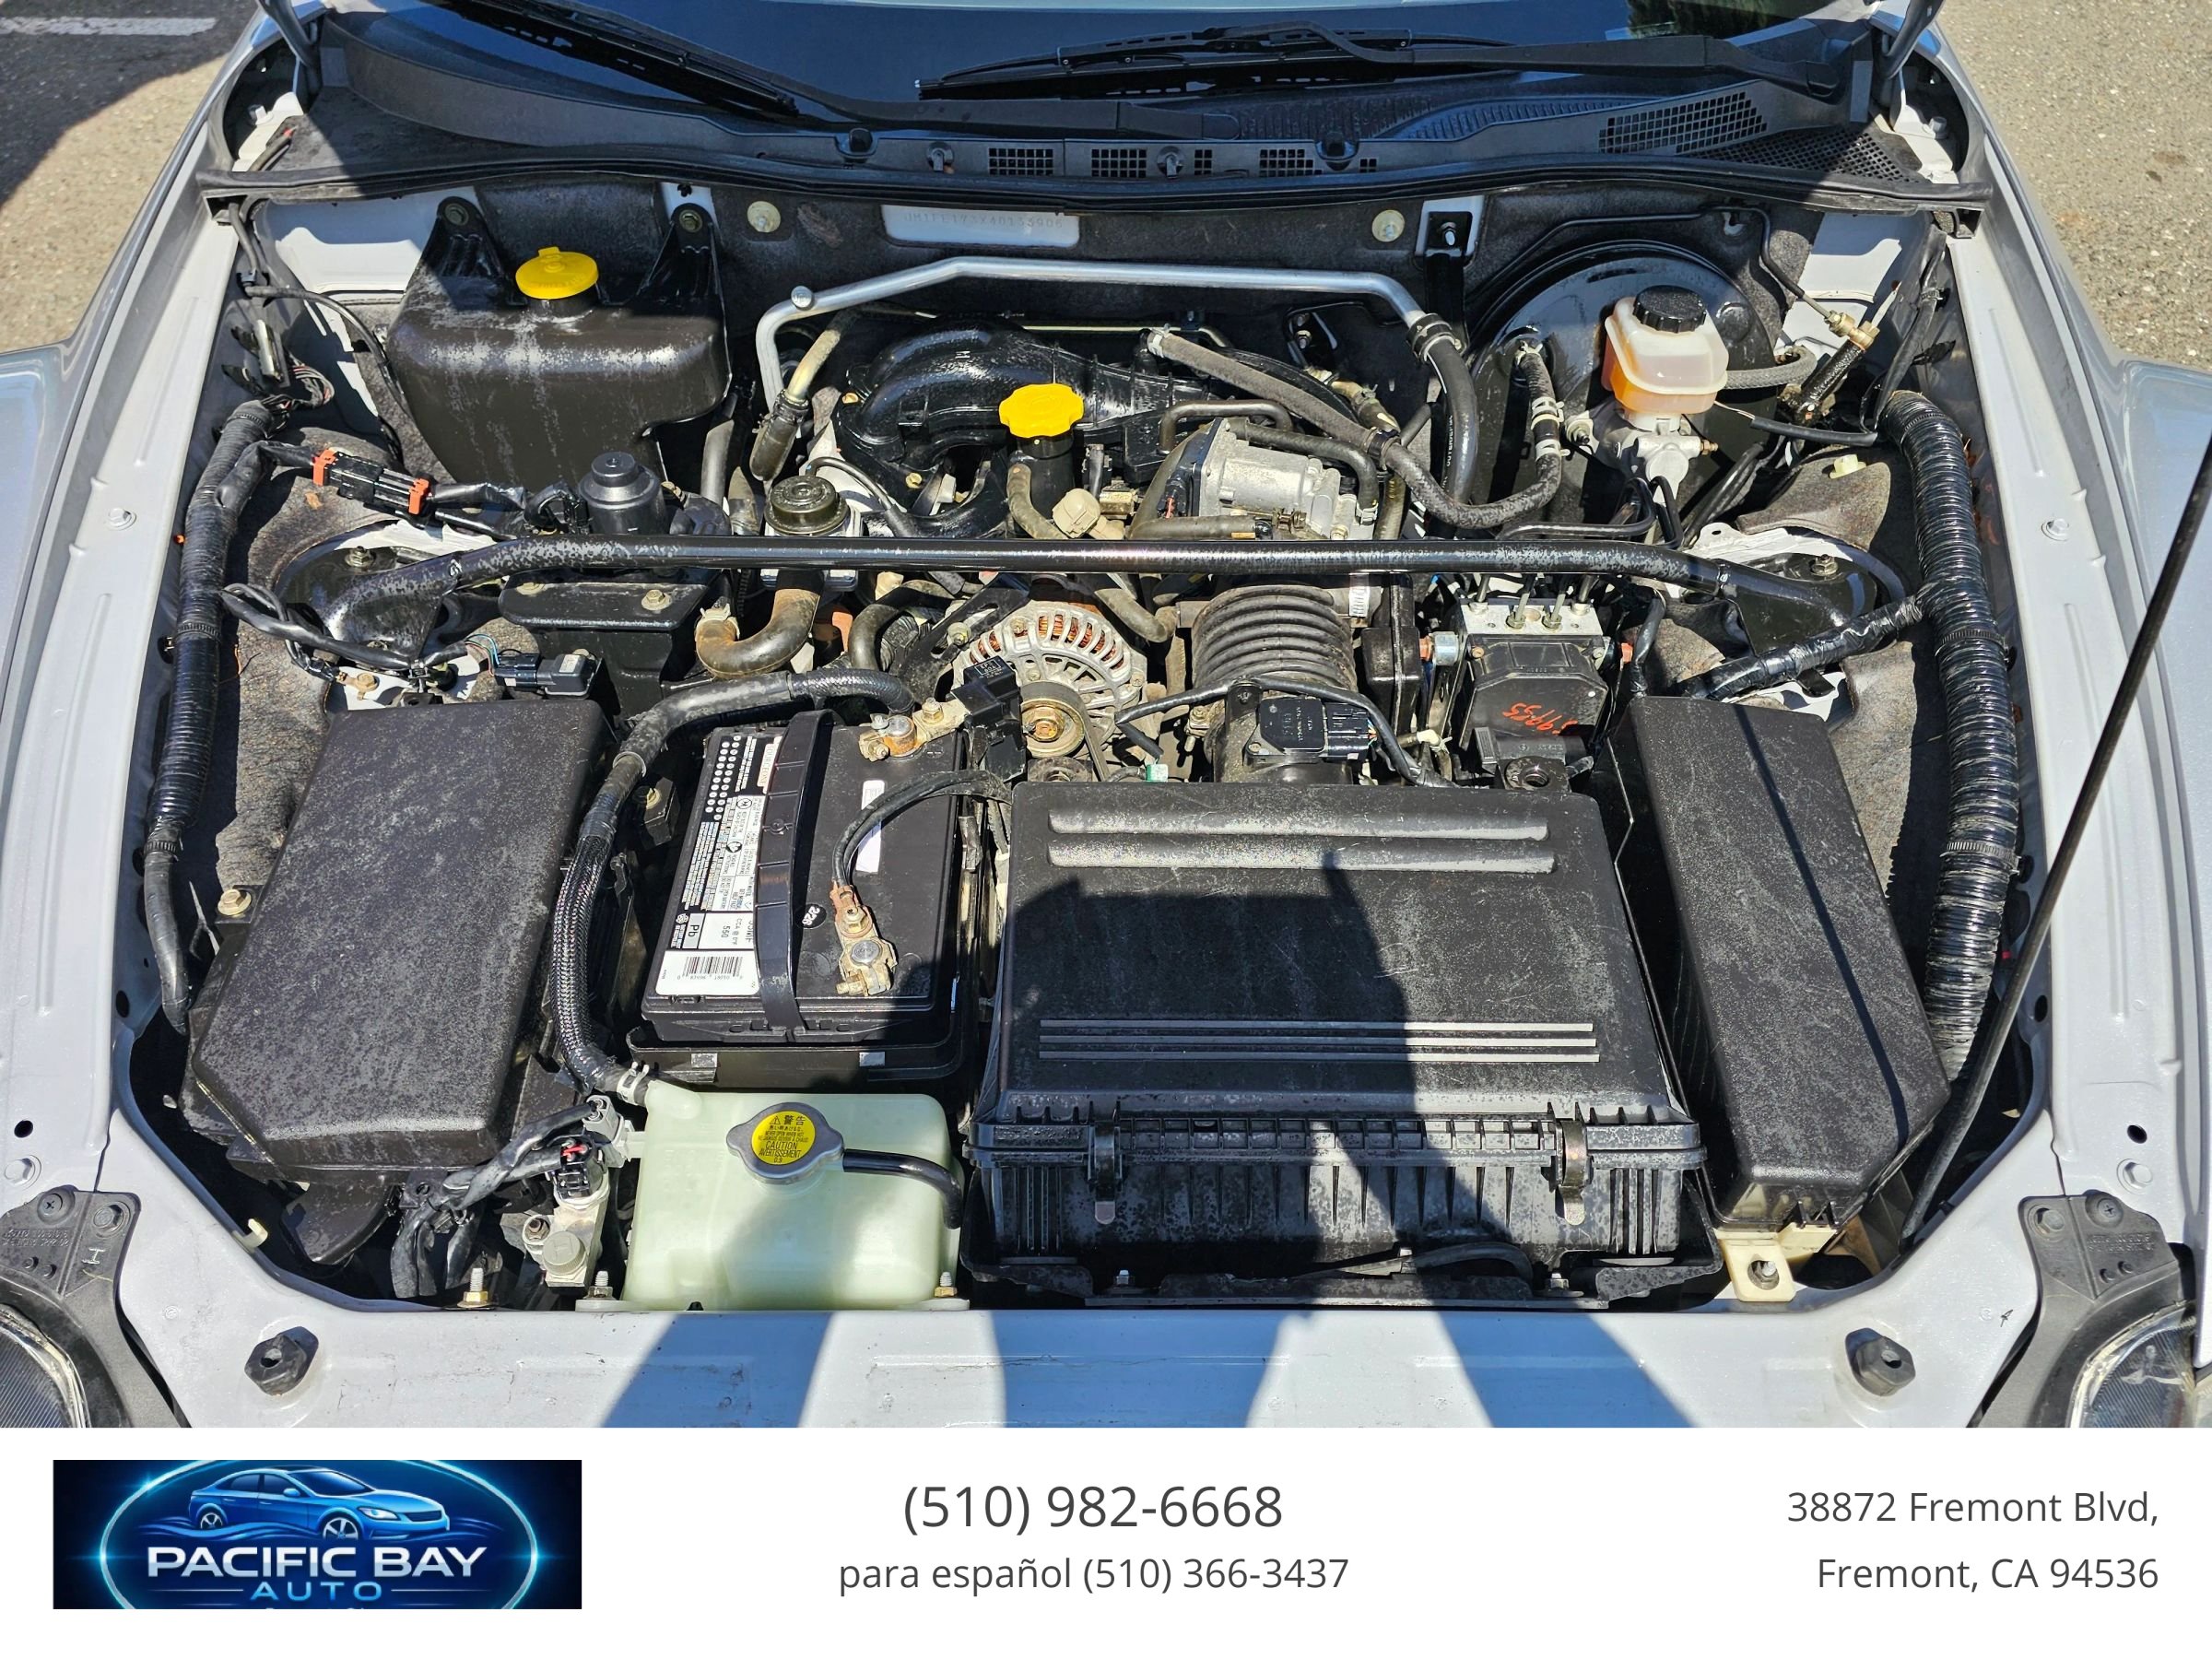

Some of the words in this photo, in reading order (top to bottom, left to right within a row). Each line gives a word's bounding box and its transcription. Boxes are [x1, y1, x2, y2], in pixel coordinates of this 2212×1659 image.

[688, 924, 700, 937] Pb
[783, 1115, 806, 1125] 警告
[765, 1141, 798, 1150] CAUTION
[759, 1148, 802, 1159] AVERTISSEMENT
